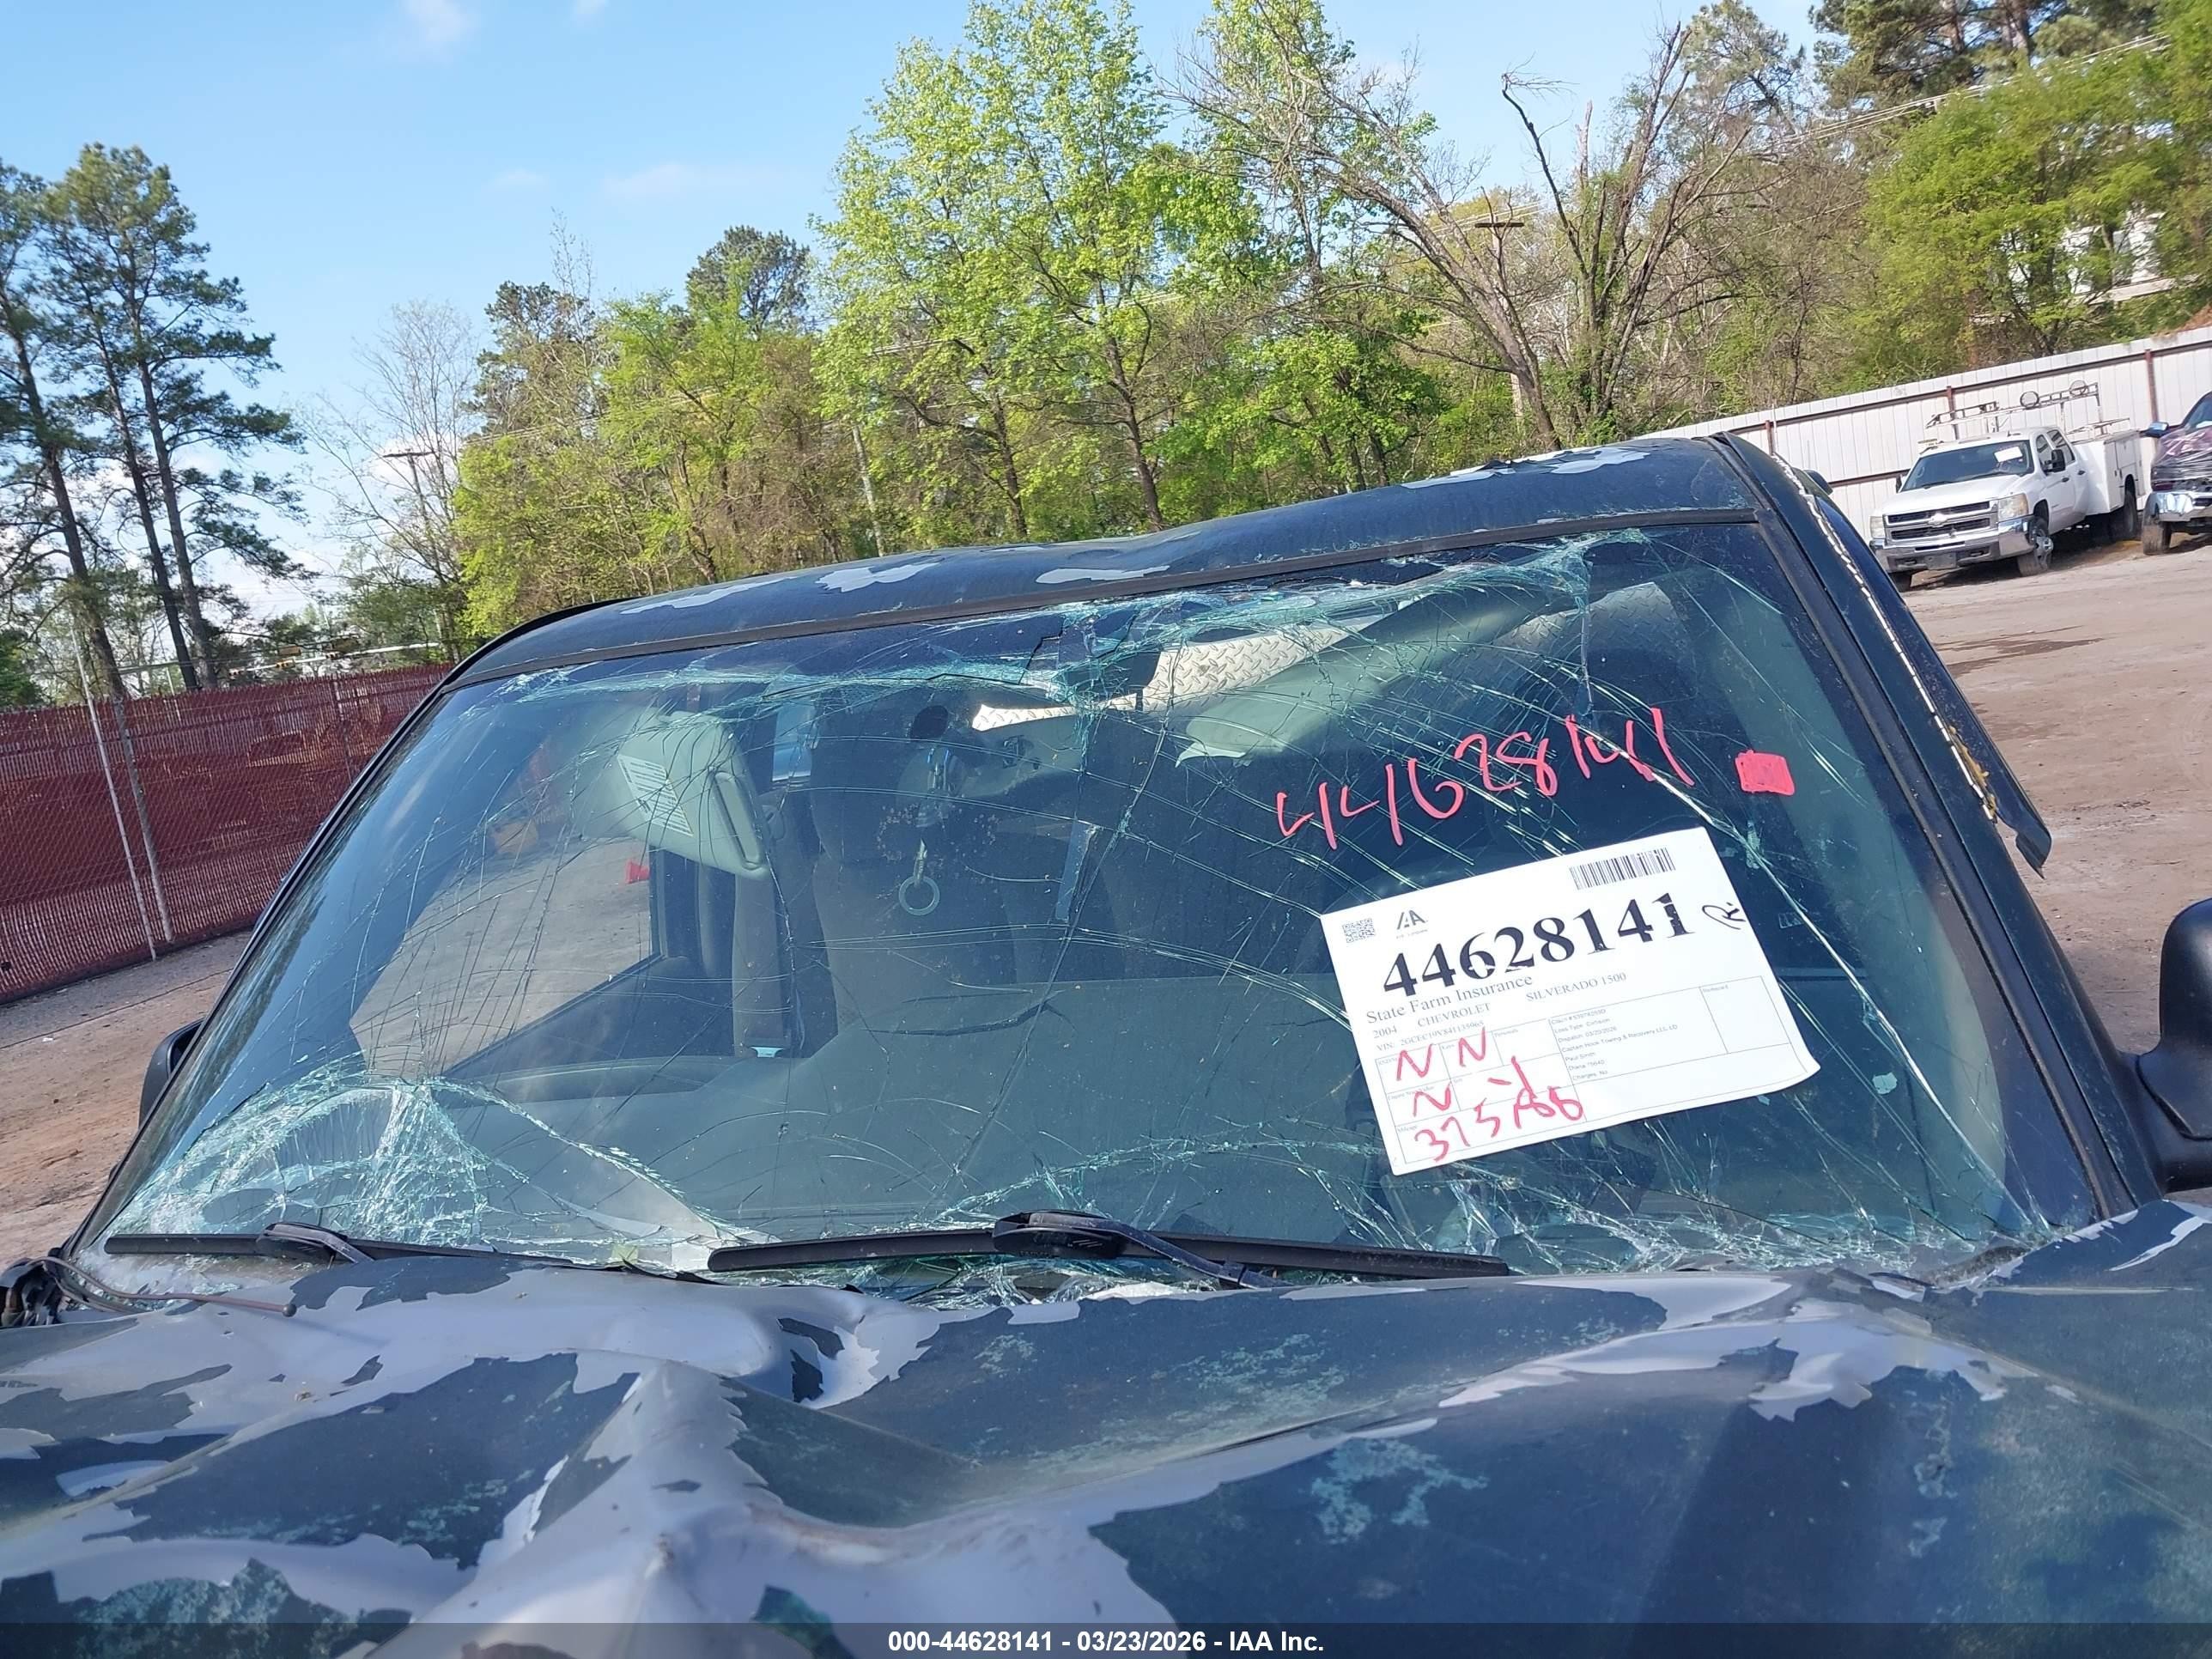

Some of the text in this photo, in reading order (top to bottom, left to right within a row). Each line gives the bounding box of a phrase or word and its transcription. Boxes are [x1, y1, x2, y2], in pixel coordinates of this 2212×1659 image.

[1383, 892, 1696, 996] 44628141
[1367, 975, 1533, 1024] State Farm Insurance
[1372, 972, 1627, 1038] 2004 CHEVROLET SILVERADO 1500
[1458, 1027, 1486, 1067] N
